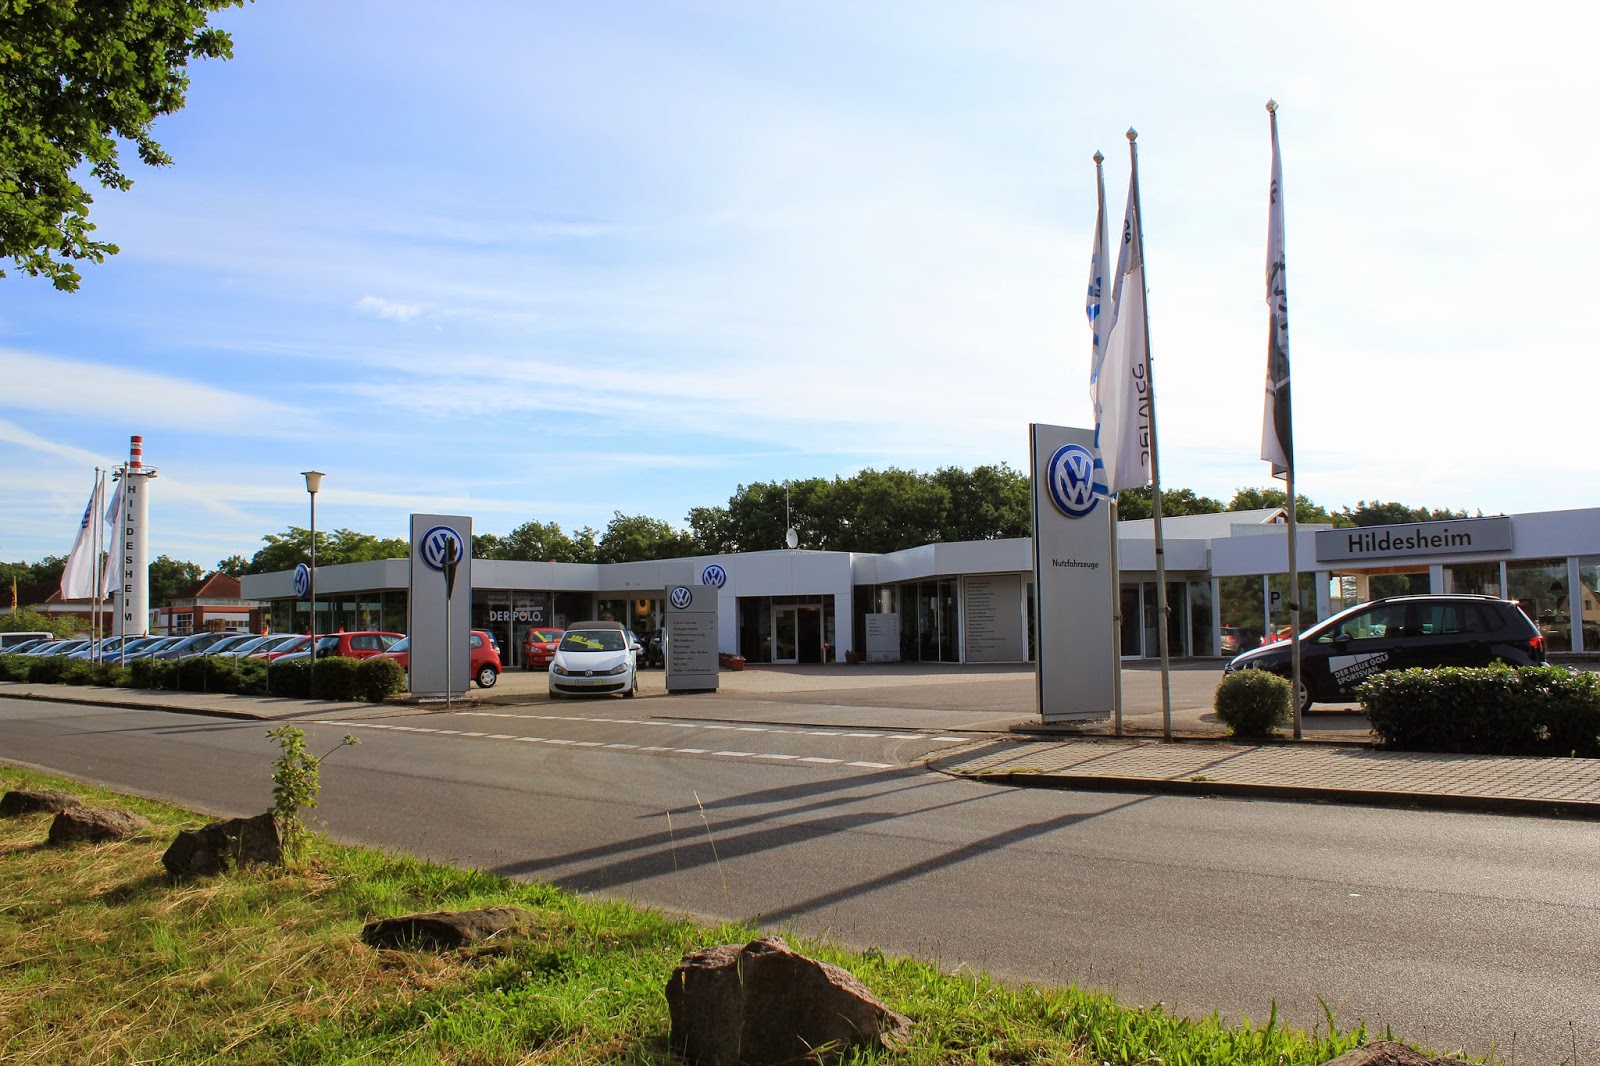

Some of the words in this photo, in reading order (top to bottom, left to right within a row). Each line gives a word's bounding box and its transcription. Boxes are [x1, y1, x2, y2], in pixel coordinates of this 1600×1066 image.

[1347, 528, 1472, 554] Hildesheim
[124, 485, 137, 621] HILDESHEIM
[1052, 558, 1099, 570] Nutzfahrzeuge
[1270, 591, 1280, 605] P
[489, 610, 510, 622] DER
[513, 610, 544, 622] POLO.
[1335, 668, 1349, 679] DER
[1349, 662, 1369, 673] NEUE
[1370, 653, 1390, 666] GOLF
[1336, 666, 1381, 685] SPORTSVAN.
